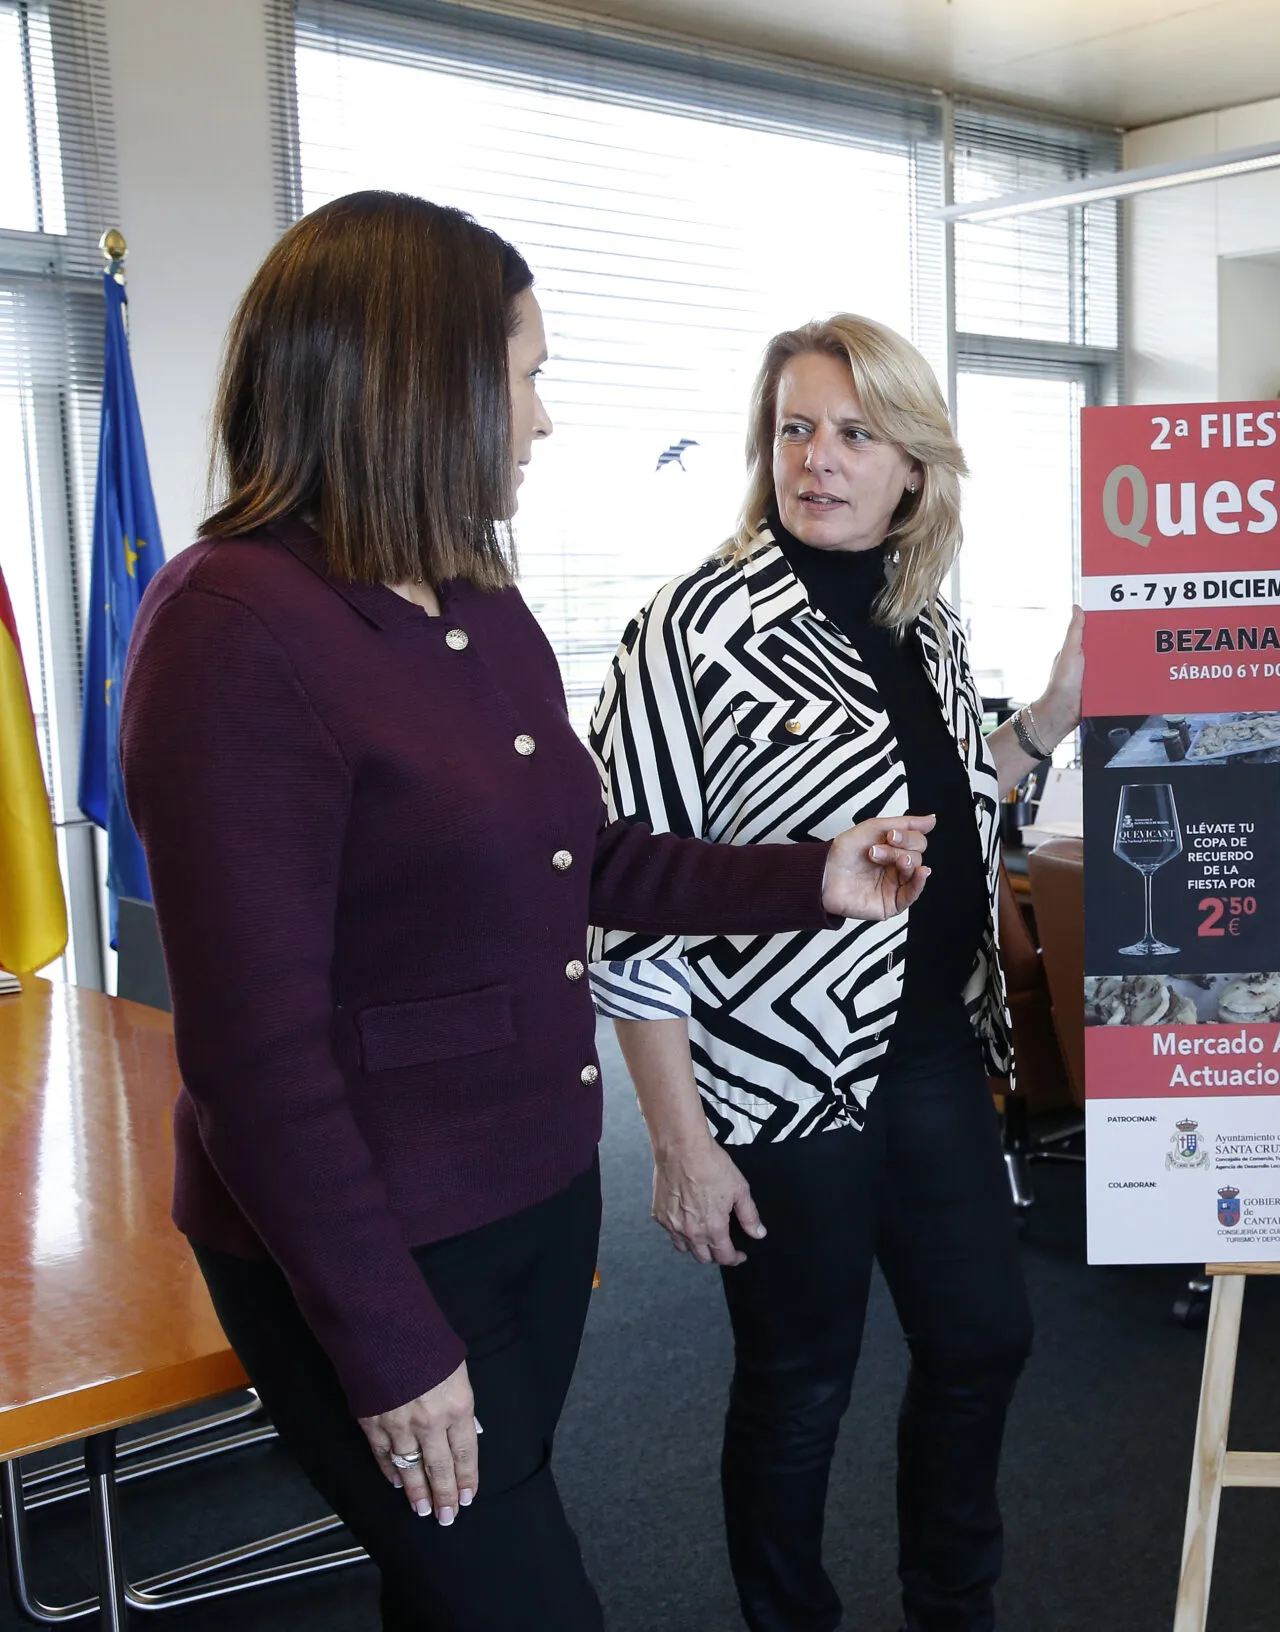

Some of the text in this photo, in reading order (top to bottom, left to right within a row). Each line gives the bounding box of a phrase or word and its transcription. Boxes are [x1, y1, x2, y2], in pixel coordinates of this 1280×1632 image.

[1110, 583, 1124, 603] 6
[1144, 582, 1157, 602] 7
[1163, 586, 1177, 607] y
[1183, 581, 1197, 600] 8
[1156, 626, 1280, 653] BEZANA
[1169, 661, 1234, 680] SÁBADO
[1237, 664, 1246, 678] 6
[1249, 663, 1259, 678] Y
[1119, 829, 1176, 839] QUEVICANT
[1186, 823, 1255, 834] LLÉVATE TU
[1193, 837, 1248, 848] COPA DE
[1188, 851, 1254, 862] RECUERDO
[1203, 865, 1239, 875] DE LA
[1187, 878, 1256, 889] FIESTA POR
[1152, 1032, 1264, 1056] Mercado
[1215, 1133, 1275, 1144] Ayuntamiento
[1215, 1144, 1253, 1155] SANTA
[1243, 1208, 1254, 1216] de
